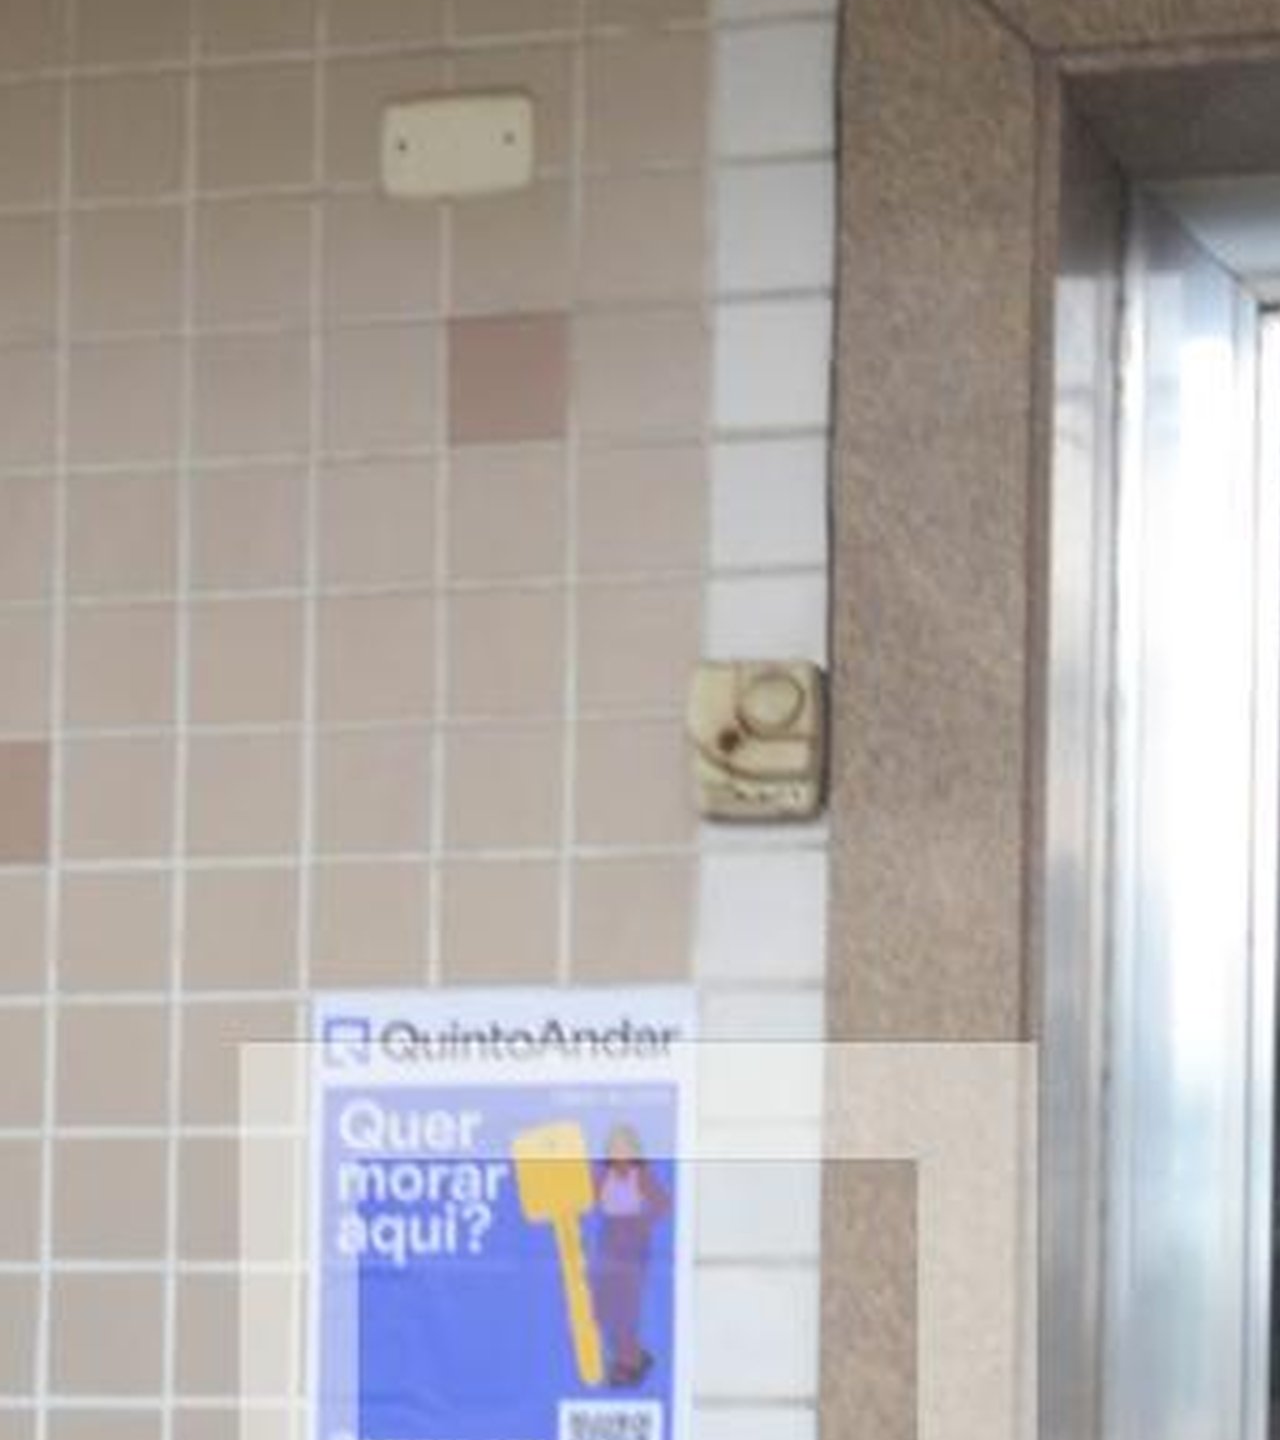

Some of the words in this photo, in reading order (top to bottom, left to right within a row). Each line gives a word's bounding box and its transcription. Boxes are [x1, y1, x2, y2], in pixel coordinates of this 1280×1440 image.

[380, 1019, 677, 1062] QuintoAndar
[339, 1100, 482, 1152] Quer
[338, 1160, 507, 1202] morar
[337, 1205, 493, 1266] aqui?
